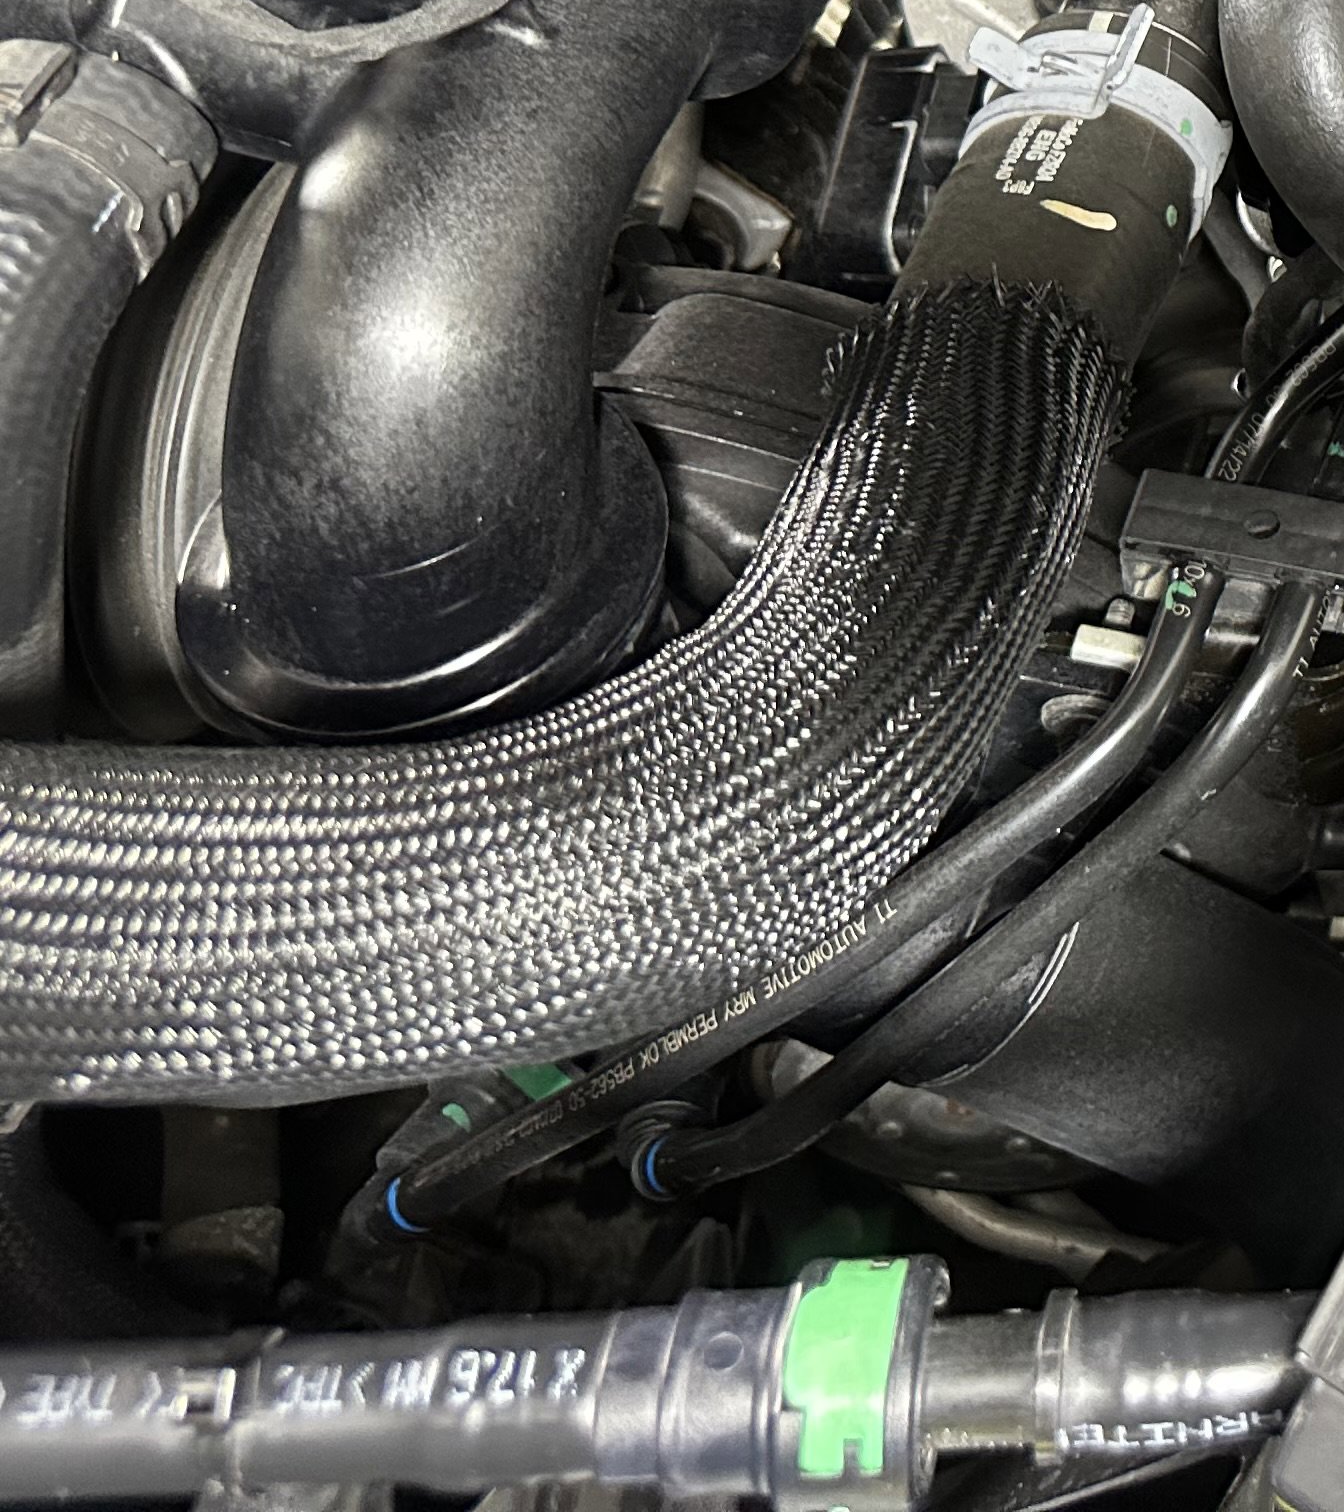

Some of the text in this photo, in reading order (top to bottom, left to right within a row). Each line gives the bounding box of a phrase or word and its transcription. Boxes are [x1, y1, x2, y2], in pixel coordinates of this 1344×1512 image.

[873, 898, 898, 924] TI
[760, 914, 867, 999] AUTOMOTIVE
[723, 986, 757, 1022] MRY
[640, 1007, 719, 1070] PERMBLOK
